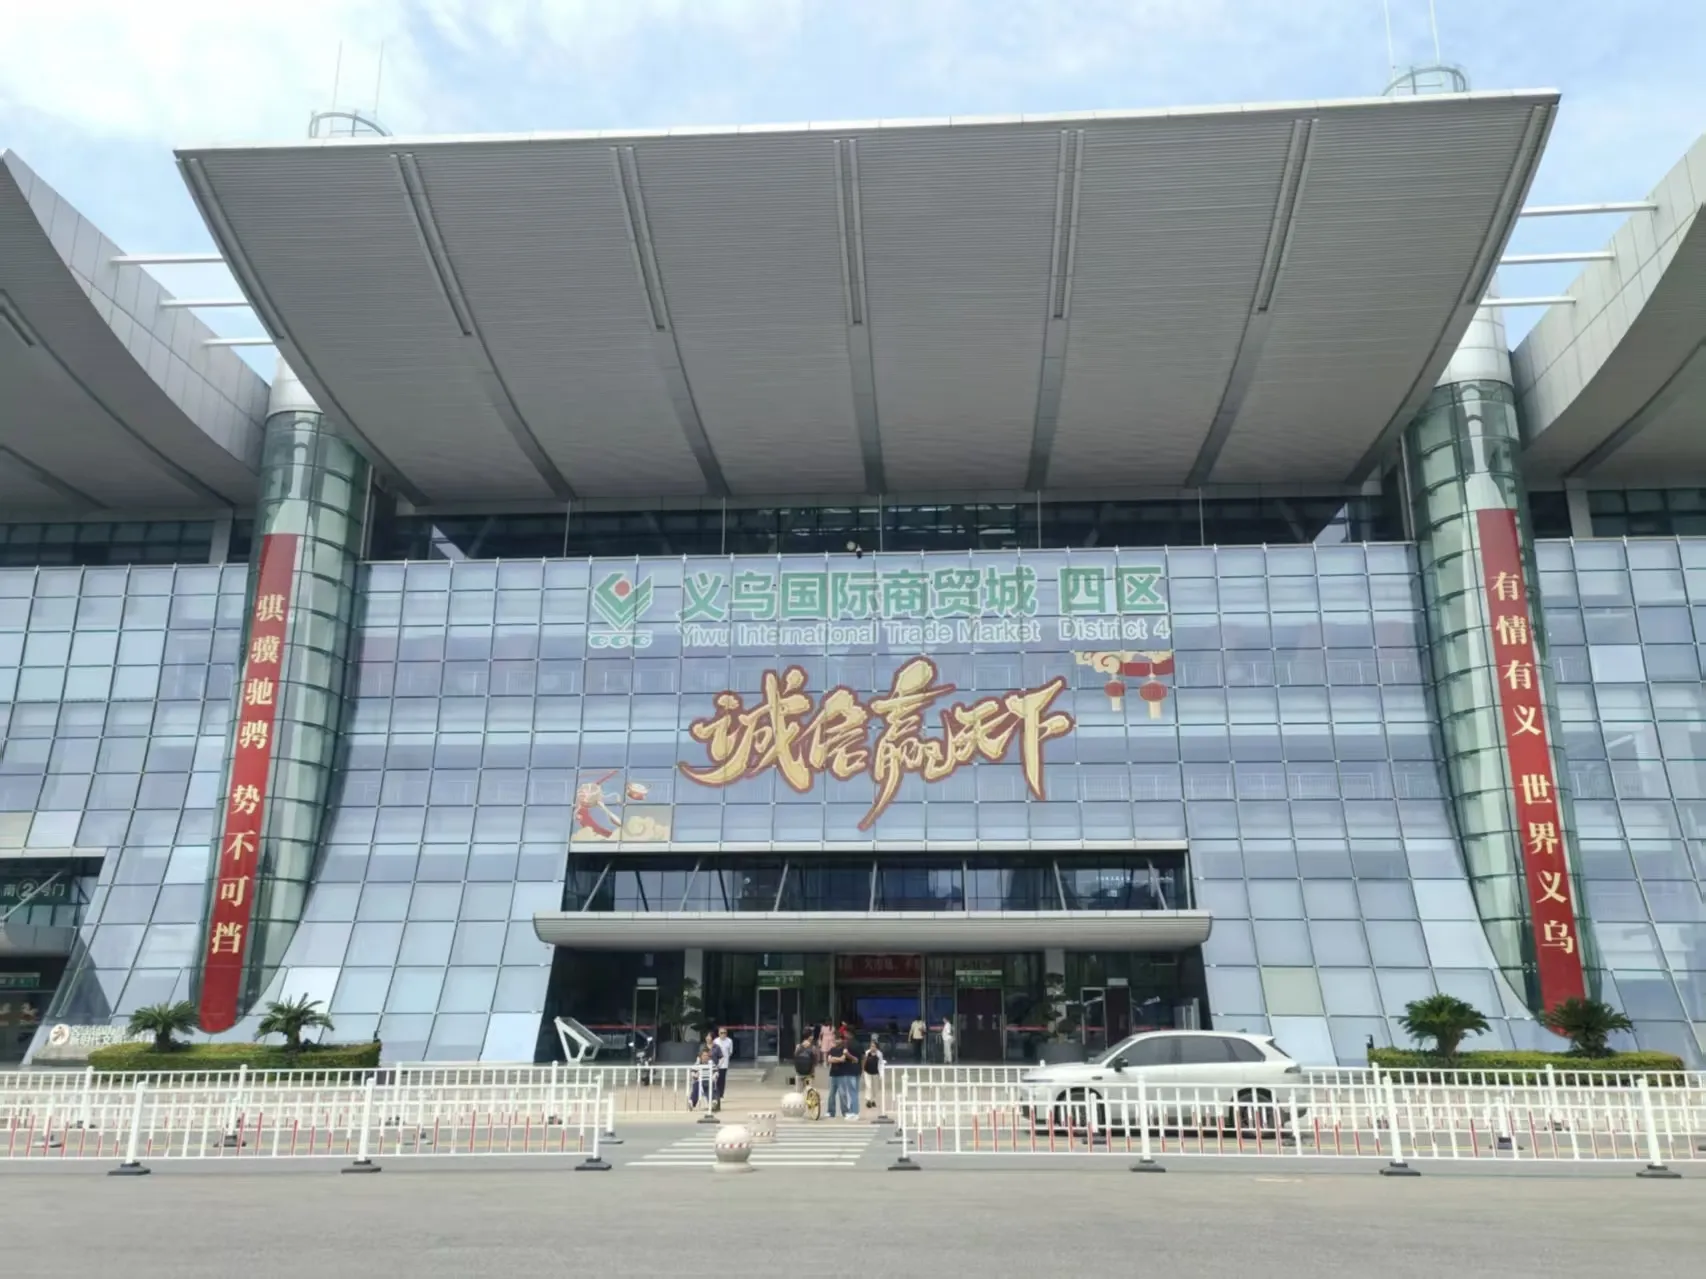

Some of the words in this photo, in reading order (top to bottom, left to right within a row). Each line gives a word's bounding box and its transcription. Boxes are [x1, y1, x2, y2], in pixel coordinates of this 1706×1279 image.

[676, 565, 1038, 622] 义乌国际商贸城
[1058, 565, 1169, 615] 四区
[676, 622, 731, 646] Yiwu
[738, 621, 879, 645] International
[883, 619, 952, 644] Trade
[957, 618, 1040, 643] Market
[1058, 617, 1148, 640] District
[1152, 616, 1171, 639] 4
[678, 656, 1078, 830] 诚信赢天下
[1490, 570, 1542, 737] 有情有义
[1518, 773, 1574, 954] 世界义乌
[211, 784, 260, 954] 势不可挡
